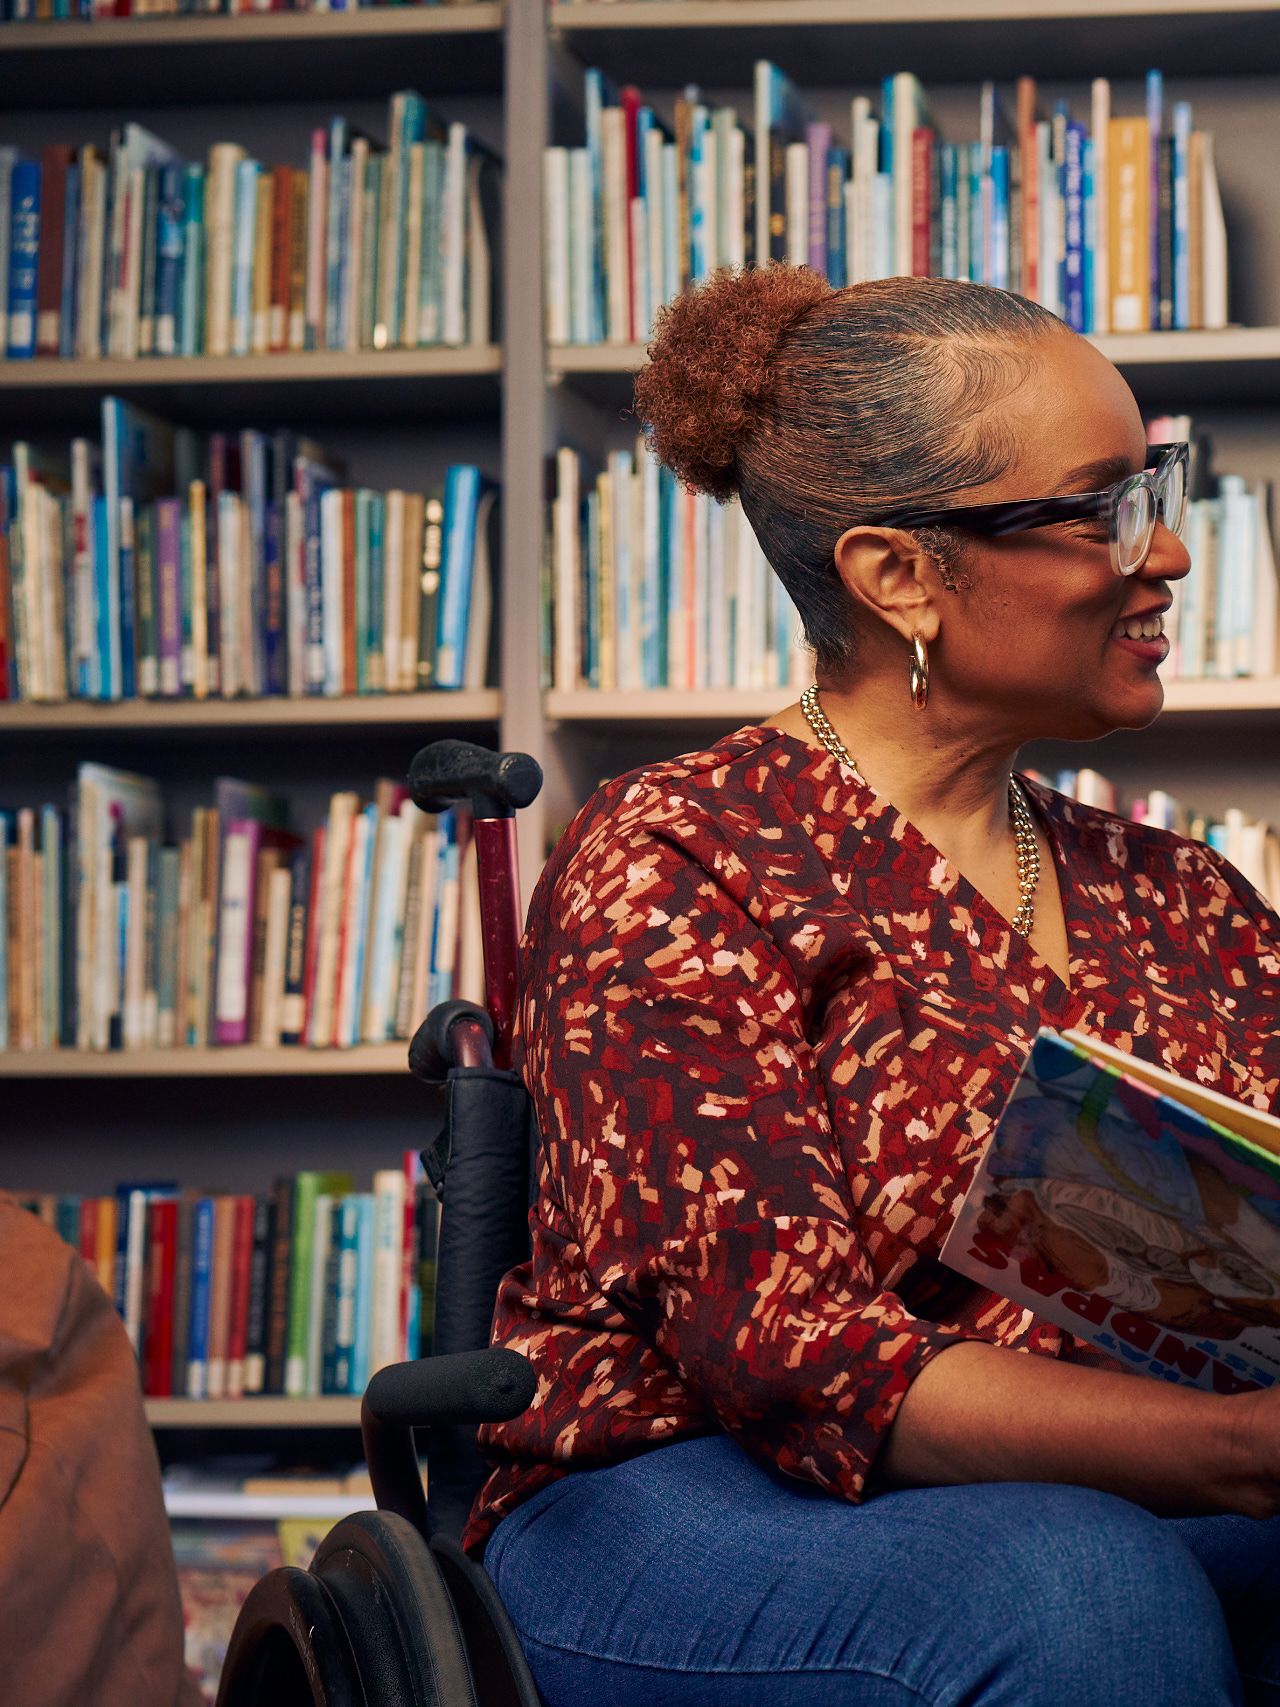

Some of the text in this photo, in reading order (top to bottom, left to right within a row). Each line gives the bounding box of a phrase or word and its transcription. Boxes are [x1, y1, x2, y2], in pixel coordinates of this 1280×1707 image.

[967, 1231, 1263, 1395] ANDPAS
[1093, 1332, 1199, 1388] HAT
[1195, 1340, 1276, 1387] EST
